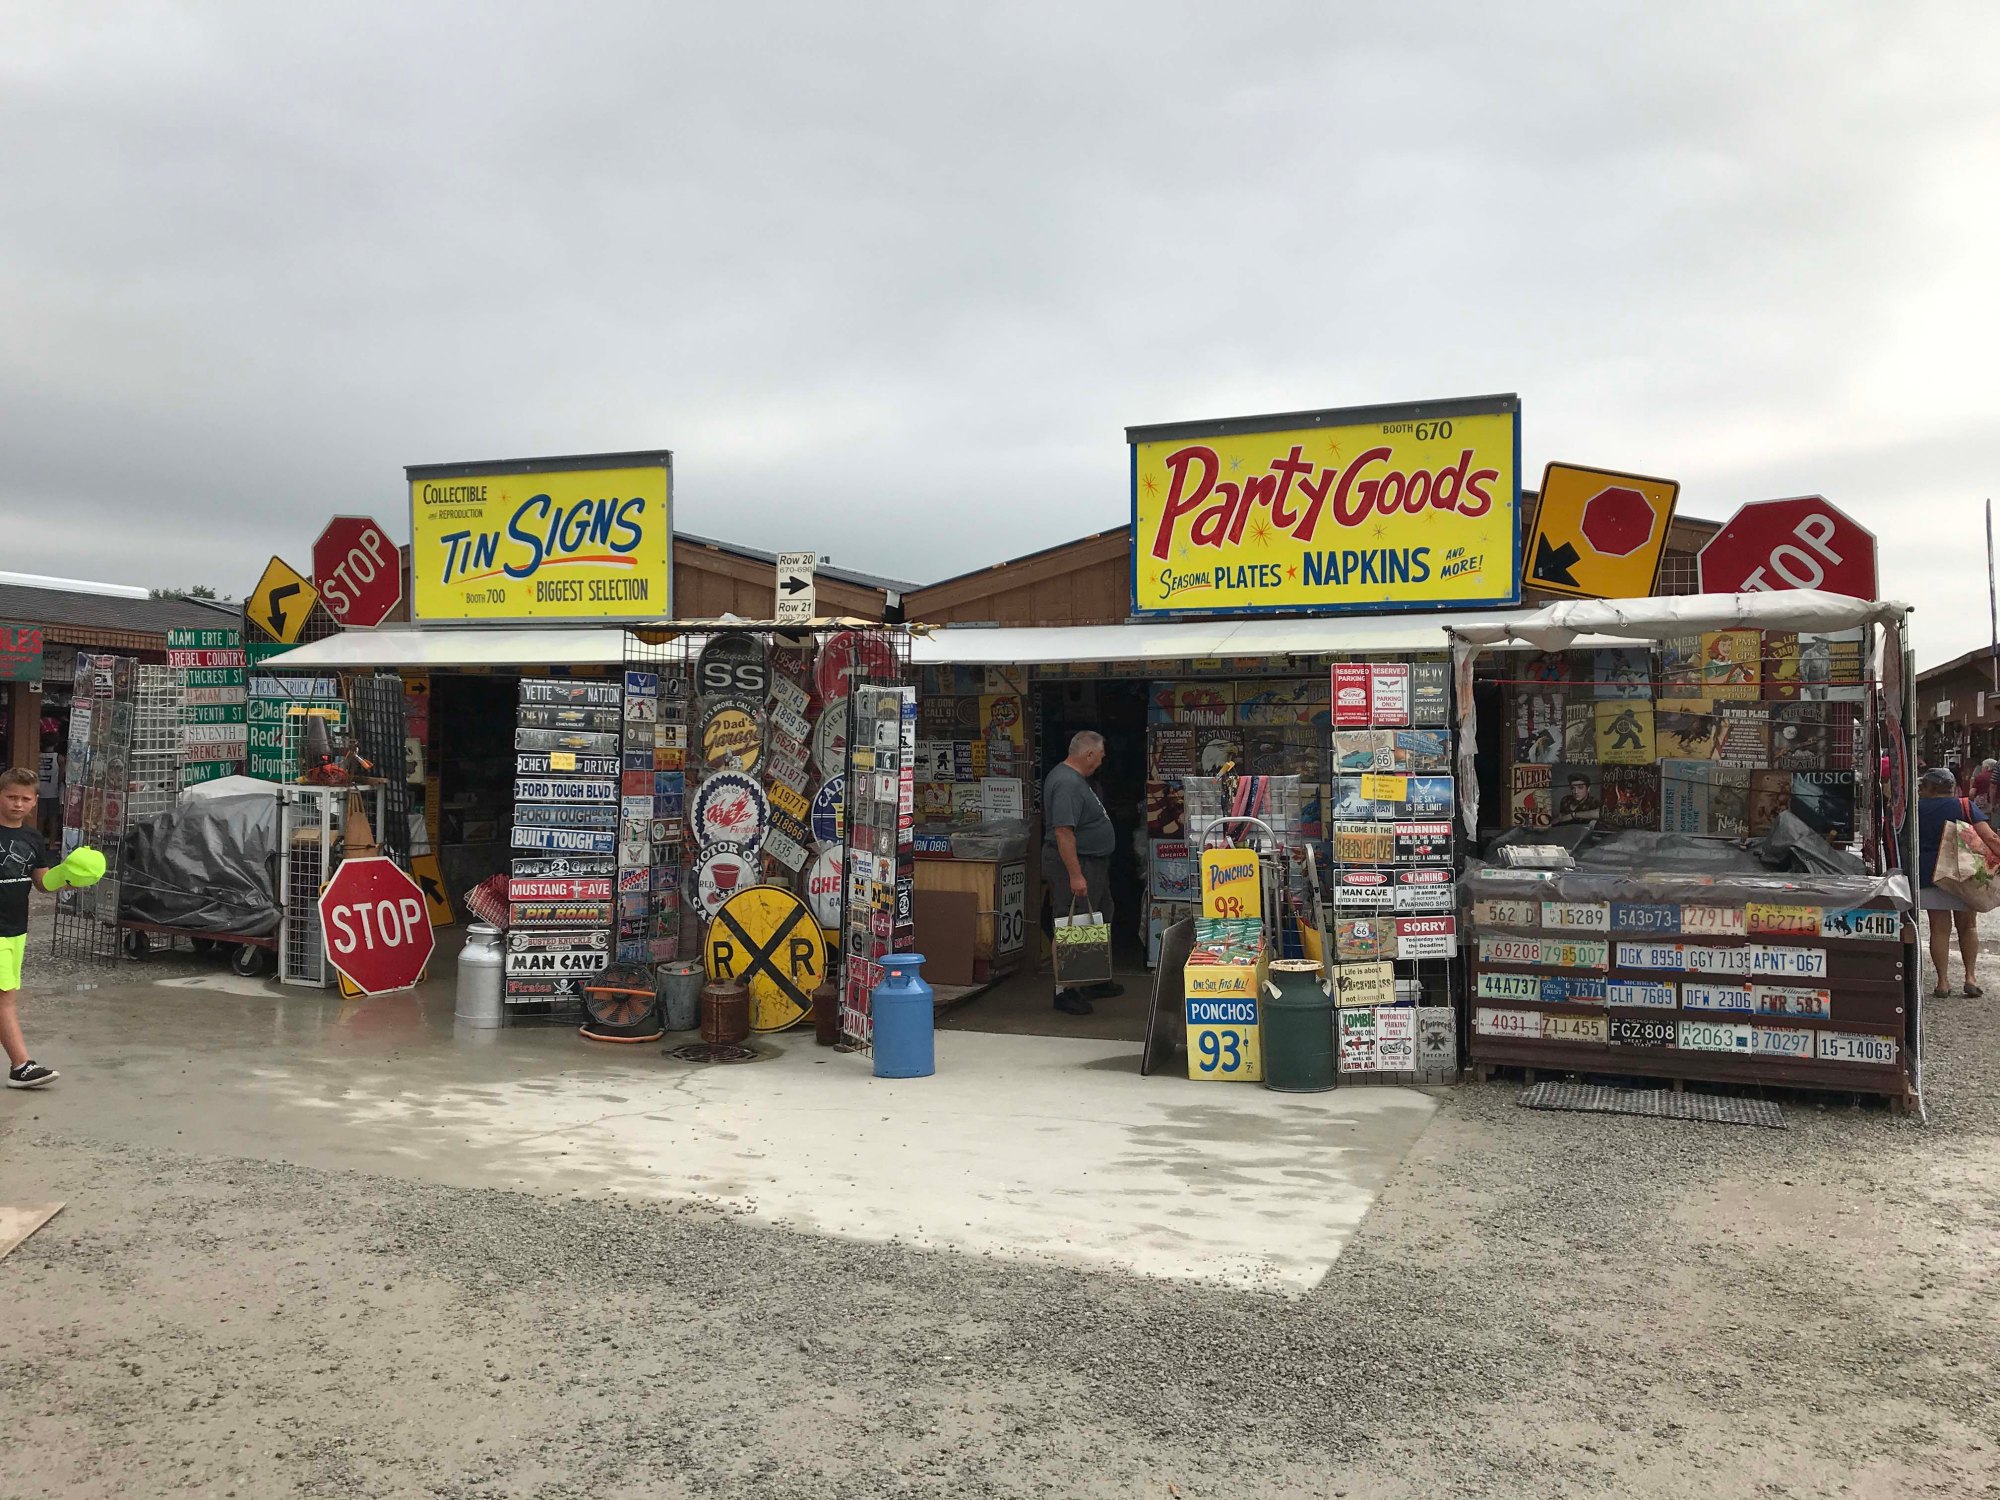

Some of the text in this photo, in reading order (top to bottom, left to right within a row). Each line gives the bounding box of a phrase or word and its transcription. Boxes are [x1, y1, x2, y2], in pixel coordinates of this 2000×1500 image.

[1383, 421, 1452, 441] BOOTH 670
[423, 484, 487, 504] COLLECTIBLE
[1152, 445, 1498, 561] Party Goods
[438, 509, 483, 519] REPRODUCTION
[441, 494, 645, 584] TIN SIGNS
[779, 555, 813, 565] Row 20
[1446, 547, 1465, 560] AND
[1740, 513, 1843, 593] TOP
[323, 528, 386, 615] STOP
[1215, 564, 1282, 589] PLATES
[1303, 547, 1430, 586] NAPKINS
[1441, 555, 1484, 579] MORE!
[486, 589, 505, 604] 700
[537, 578, 648, 602] BIGGEST SELECTION
[778, 602, 811, 612] Row 21
[168, 631, 239, 646] MIAMI ERTE DR
[1735, 638, 1757, 646] PMS
[175, 653, 201, 667] REBEL
[1735, 651, 1756, 660] GPS
[234, 669, 243, 683] ST
[704, 663, 764, 690] SS
[227, 689, 238, 700] ST
[286, 681, 309, 694] TRUCK
[588, 687, 619, 703] NATION
[232, 706, 242, 720] ST
[1723, 709, 1770, 719] IN THIS PLACE
[189, 727, 236, 741] SEVENTH
[226, 745, 242, 758] AVE
[584, 759, 615, 773] DRIVE
[1376, 754, 1389, 765] 66
[1715, 772, 1732, 786] You
[1796, 772, 1852, 785] MUSIC
[522, 783, 549, 796] FORD
[552, 784, 583, 798] TOUGH
[586, 785, 611, 798] BLVD
[1405, 803, 1442, 812] IS THE LIMIT
[520, 808, 591, 823] FORD TOUGH
[1337, 825, 1367, 833] WELCOME
[1395, 825, 1448, 834] WARNING
[514, 829, 550, 847] BUILT
[552, 831, 594, 850] TOUGH
[929, 840, 947, 852] 088
[514, 862, 614, 874] Dad's 24 Garage
[1002, 872, 1025, 887] SPEED
[1210, 863, 1254, 891] PONCHOS
[1407, 873, 1443, 882] WARNING
[512, 884, 609, 896] MUSTANG AVE
[1004, 891, 1021, 906] LIMIT
[525, 908, 598, 920] PIT ROAD
[1489, 906, 1515, 922] 562
[1559, 909, 1603, 925] 15289
[331, 898, 422, 954] STOP
[1000, 909, 1023, 945] 30
[1356, 927, 1366, 935] 66
[1403, 921, 1447, 932] SORRY
[1855, 917, 1895, 934] 64HD
[528, 937, 592, 945] BUSTED KNUCKLE
[713, 938, 815, 978] R R
[1496, 943, 1539, 959] 69208
[1620, 948, 1683, 967] DGK 8958
[512, 954, 604, 971] MAN CAVE
[1690, 952, 1713, 968] GGY
[1753, 953, 1823, 972] APNT 067
[1218, 979, 1232, 990] FITS
[1233, 978, 1249, 990] ALL!
[1486, 977, 1537, 995] 44A737
[1610, 987, 1672, 1005] CLH 7689
[1686, 989, 1751, 1008] DFW 2306
[1191, 1003, 1255, 1021] PONCHOS
[1492, 1014, 1525, 1032] 4031
[1572, 1020, 1599, 1036] 455
[1692, 1027, 1733, 1047] 2063
[1764, 1032, 1809, 1052] 70297
[1821, 1038, 1892, 1060] 15-14063
